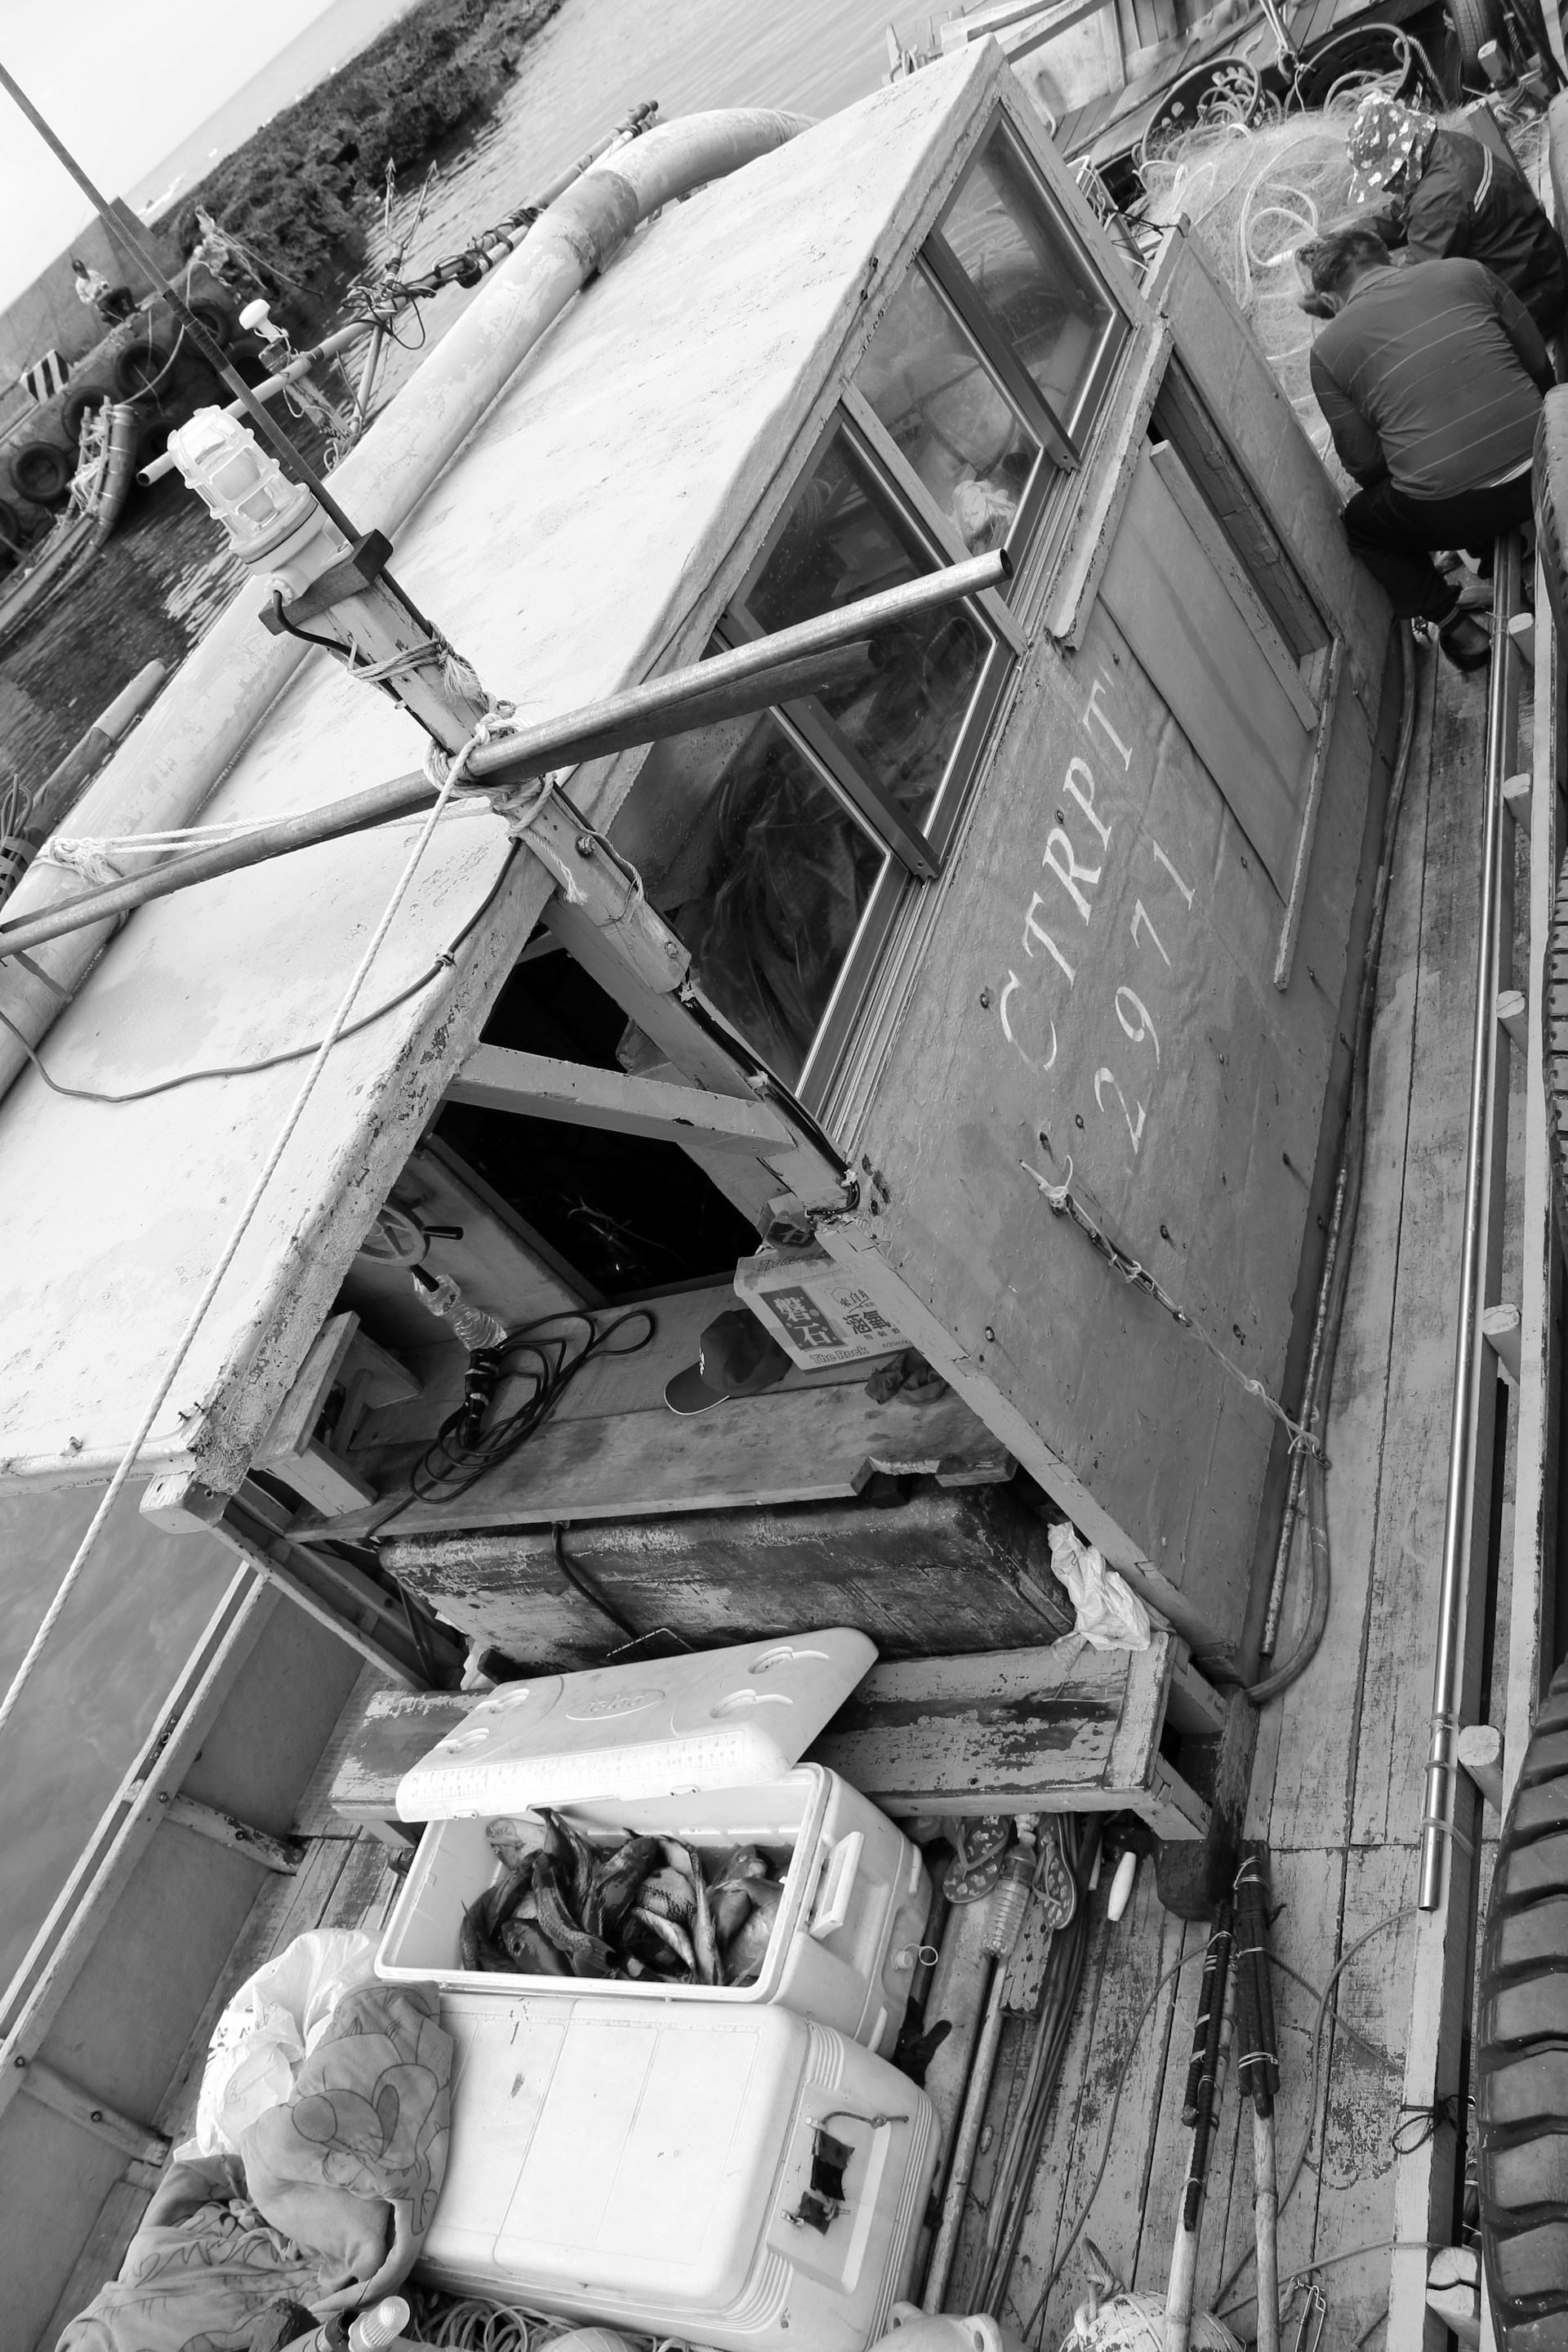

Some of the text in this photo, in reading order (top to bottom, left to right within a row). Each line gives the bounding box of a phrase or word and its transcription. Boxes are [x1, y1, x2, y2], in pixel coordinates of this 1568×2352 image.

[1094, 840, 1196, 1155] 2971
[758, 1258, 782, 1272] The
[809, 1345, 871, 1365] The Rock
